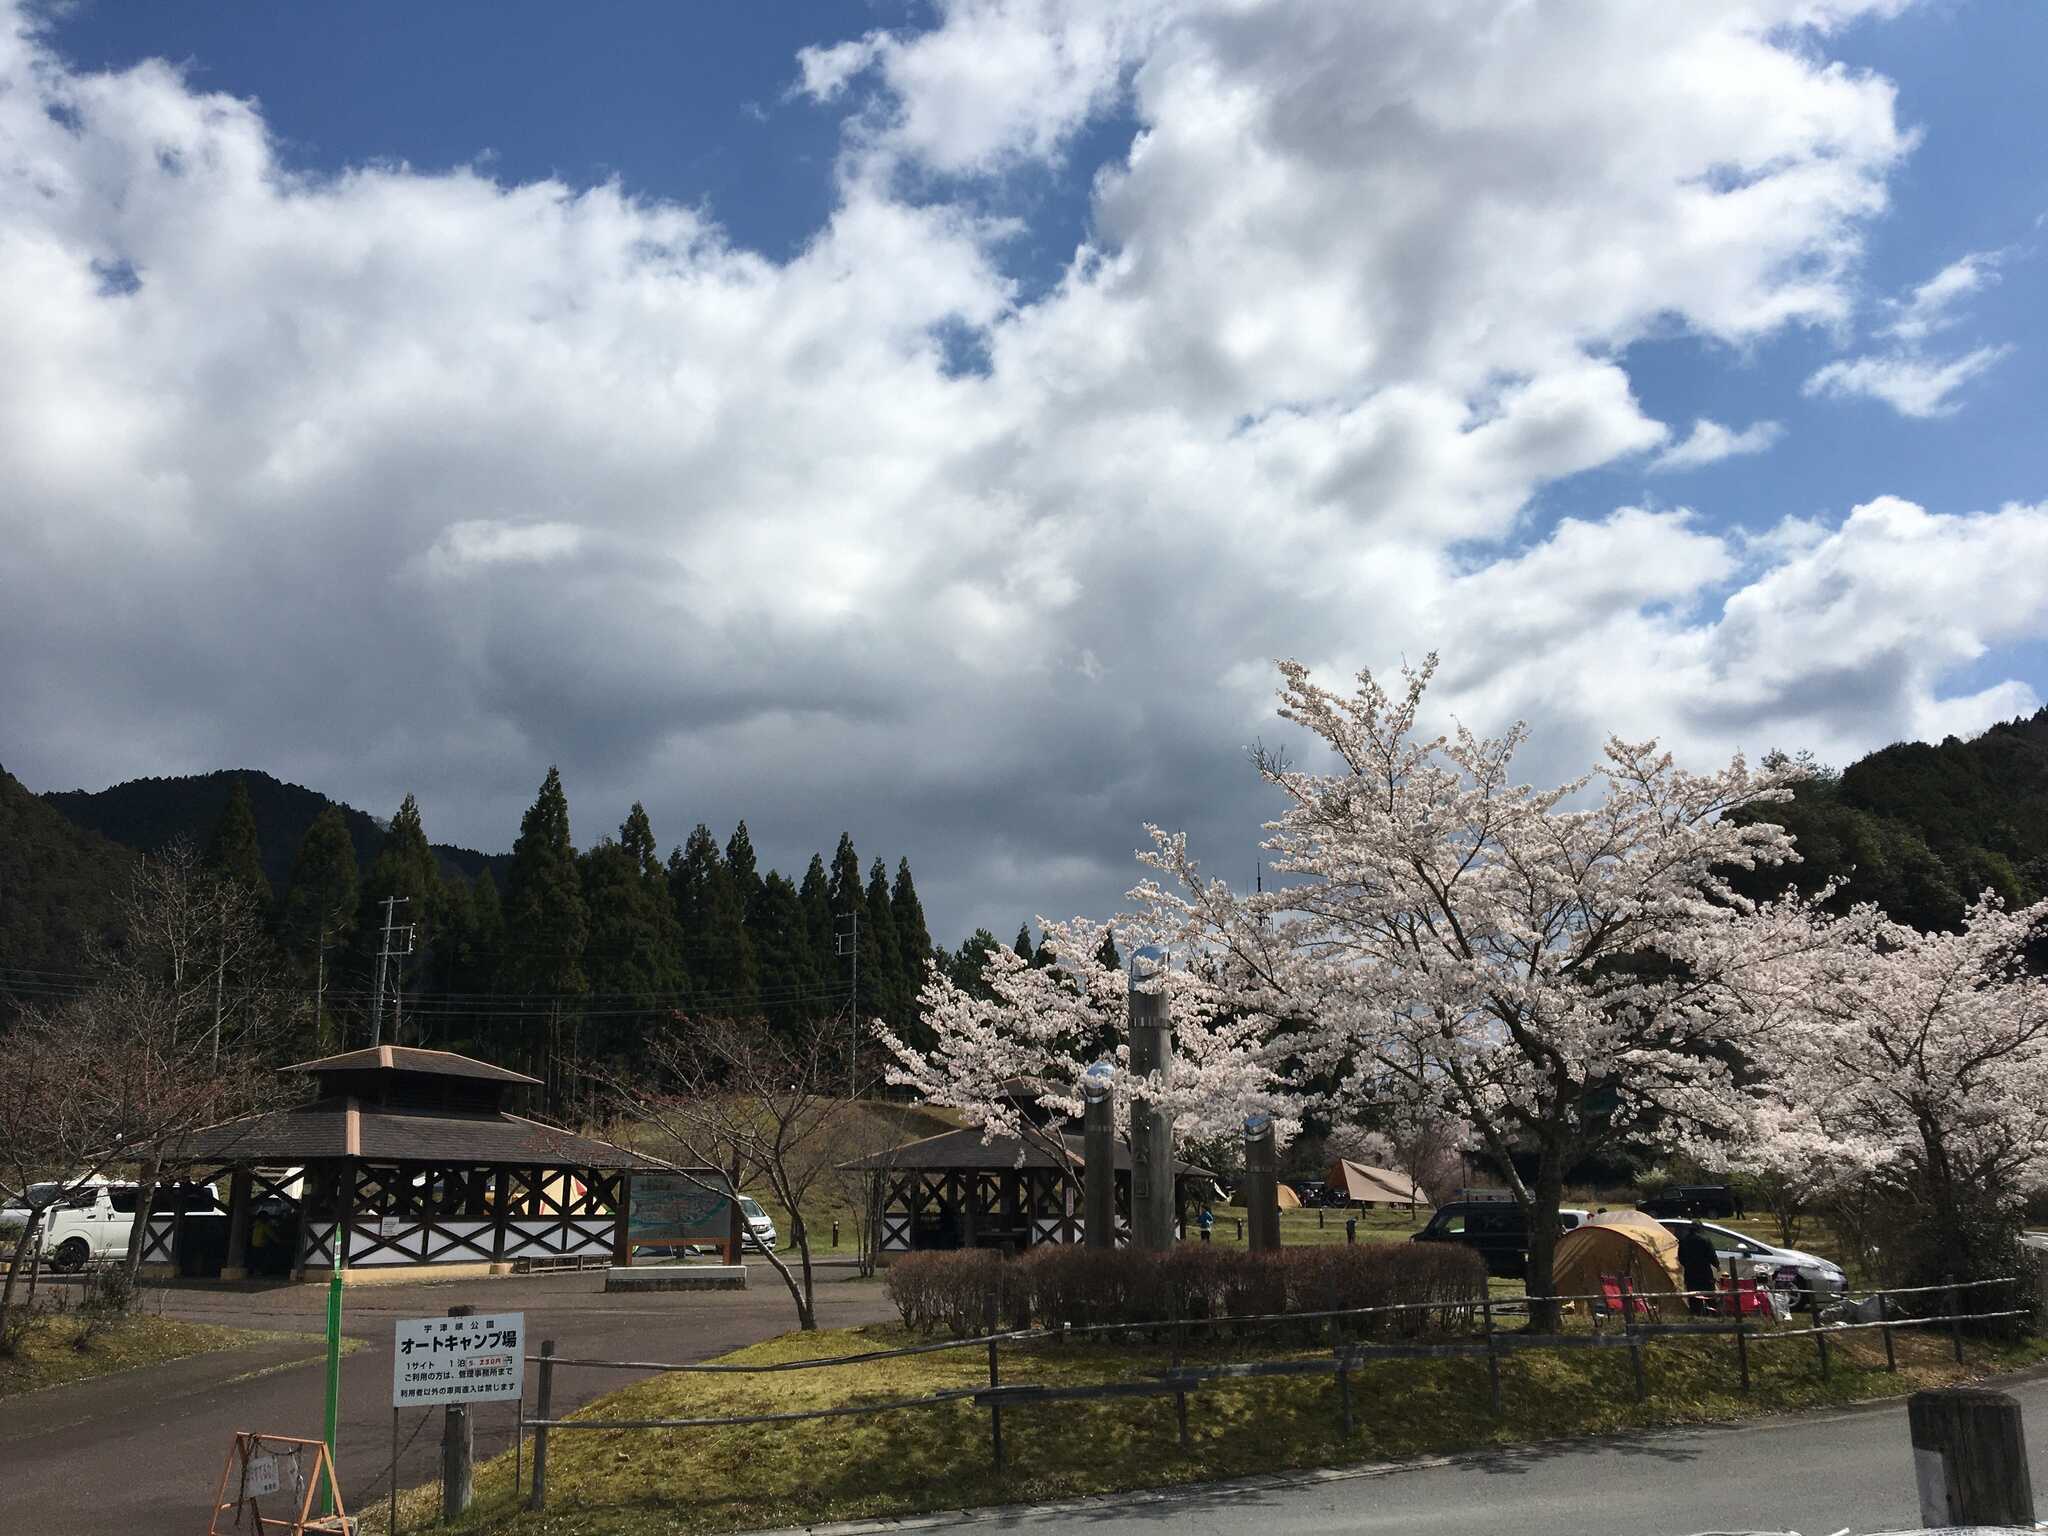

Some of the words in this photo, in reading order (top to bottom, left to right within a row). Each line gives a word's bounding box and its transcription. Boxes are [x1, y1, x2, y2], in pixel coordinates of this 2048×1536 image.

[401, 1330, 517, 1355] オートキャンプ場
